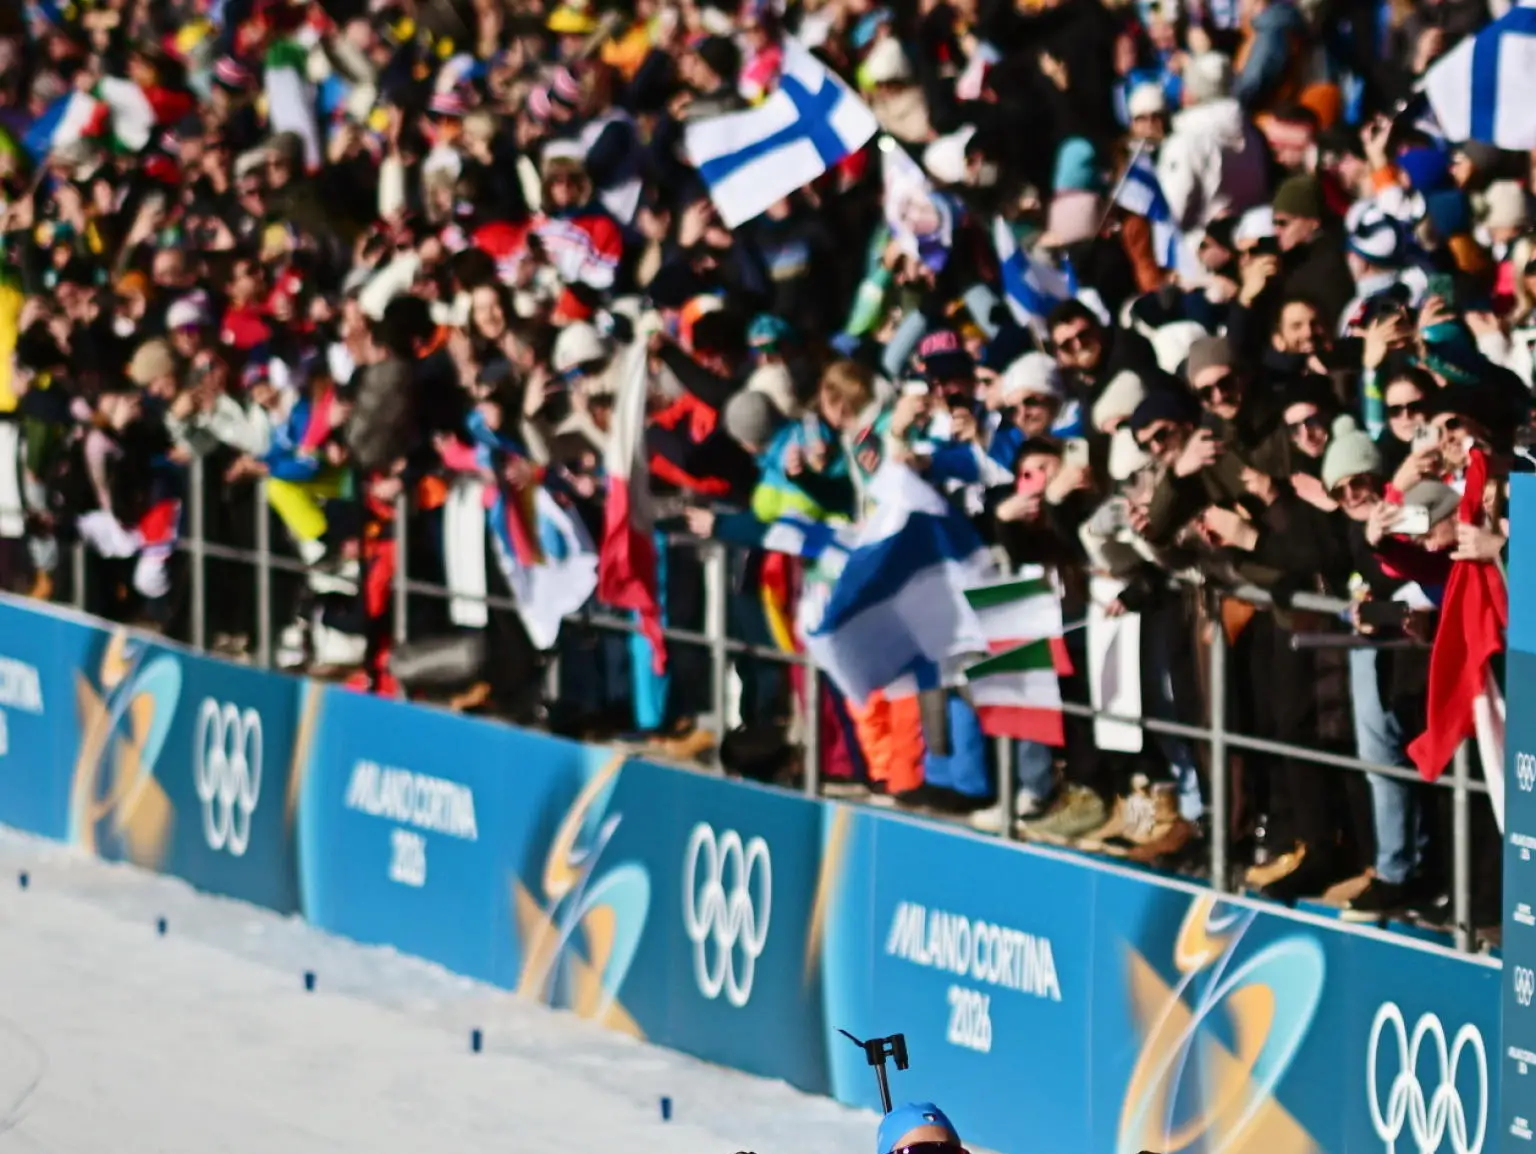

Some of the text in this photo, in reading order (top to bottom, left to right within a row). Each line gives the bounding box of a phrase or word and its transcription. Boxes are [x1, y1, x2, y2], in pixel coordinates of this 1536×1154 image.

[886, 900, 1062, 1002] MILANO CORTINA
[946, 984, 992, 1053] 2026
